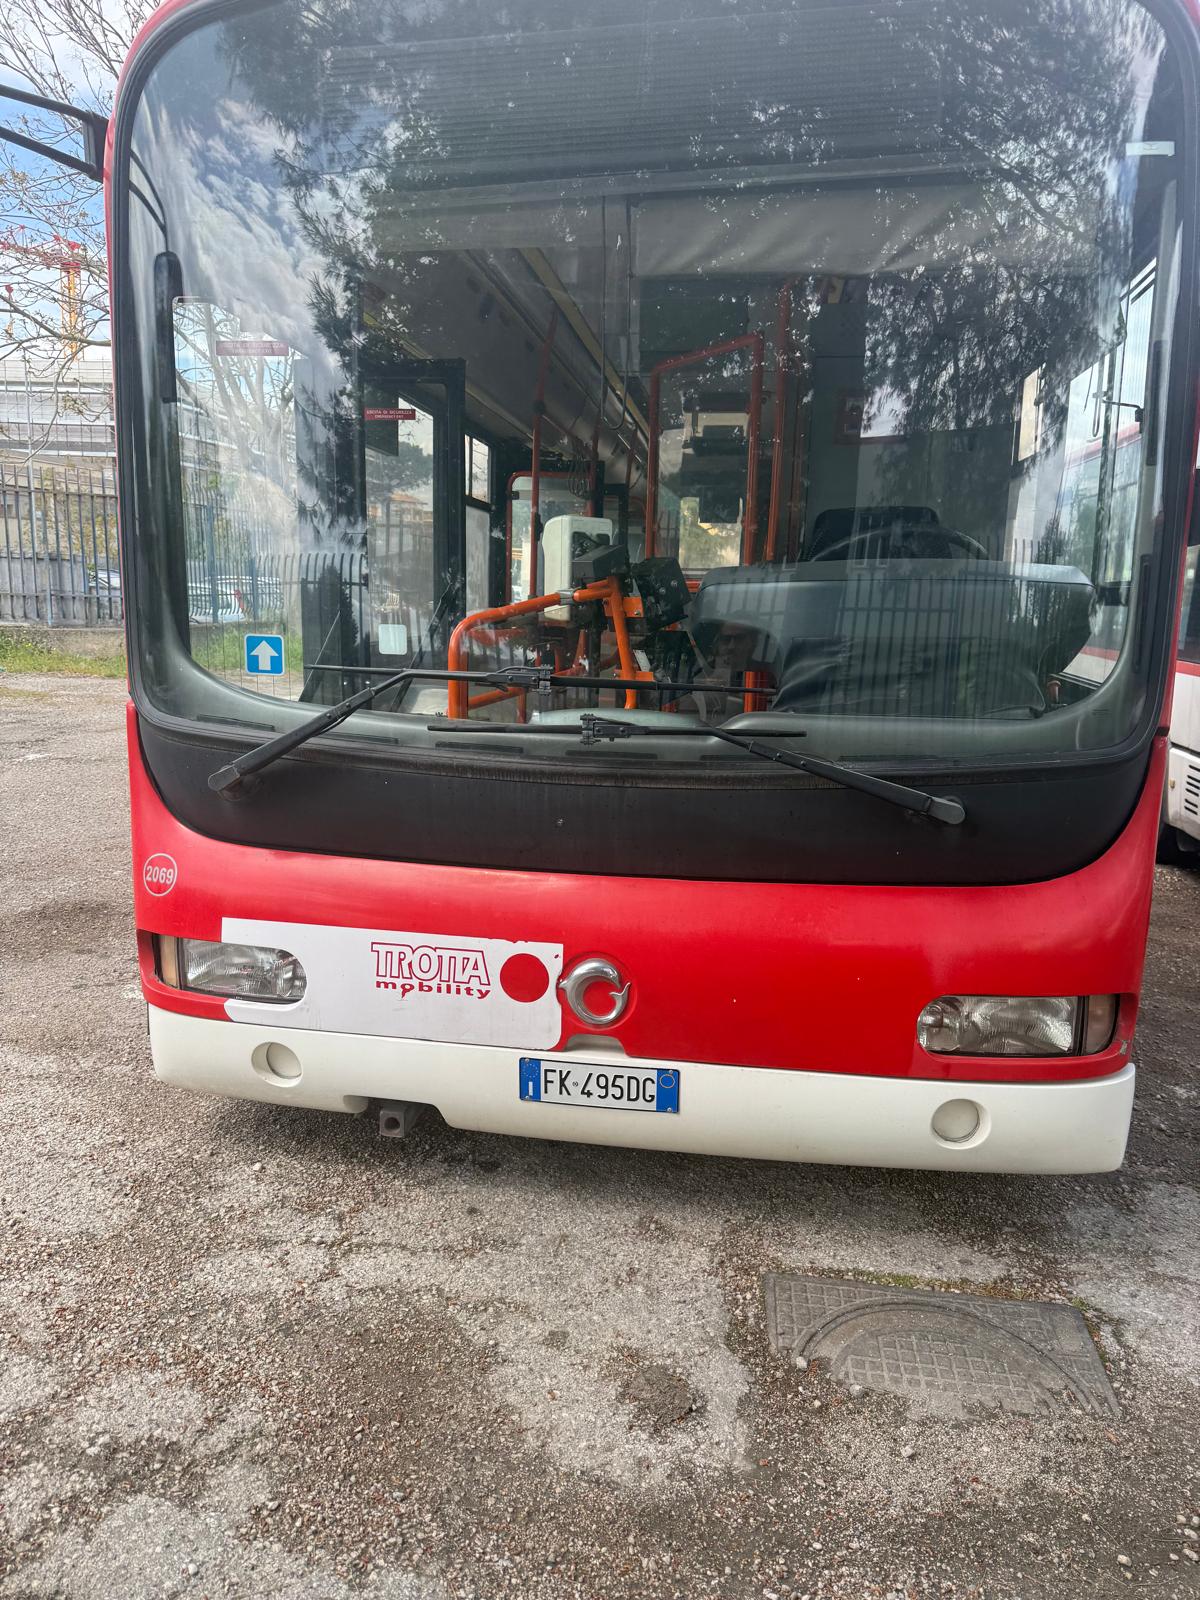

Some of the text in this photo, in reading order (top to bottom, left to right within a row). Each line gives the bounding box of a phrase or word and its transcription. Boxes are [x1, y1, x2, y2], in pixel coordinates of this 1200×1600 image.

[146, 865, 175, 885] 2069
[371, 942, 491, 986] TROTTA
[376, 981, 491, 999] mobility
